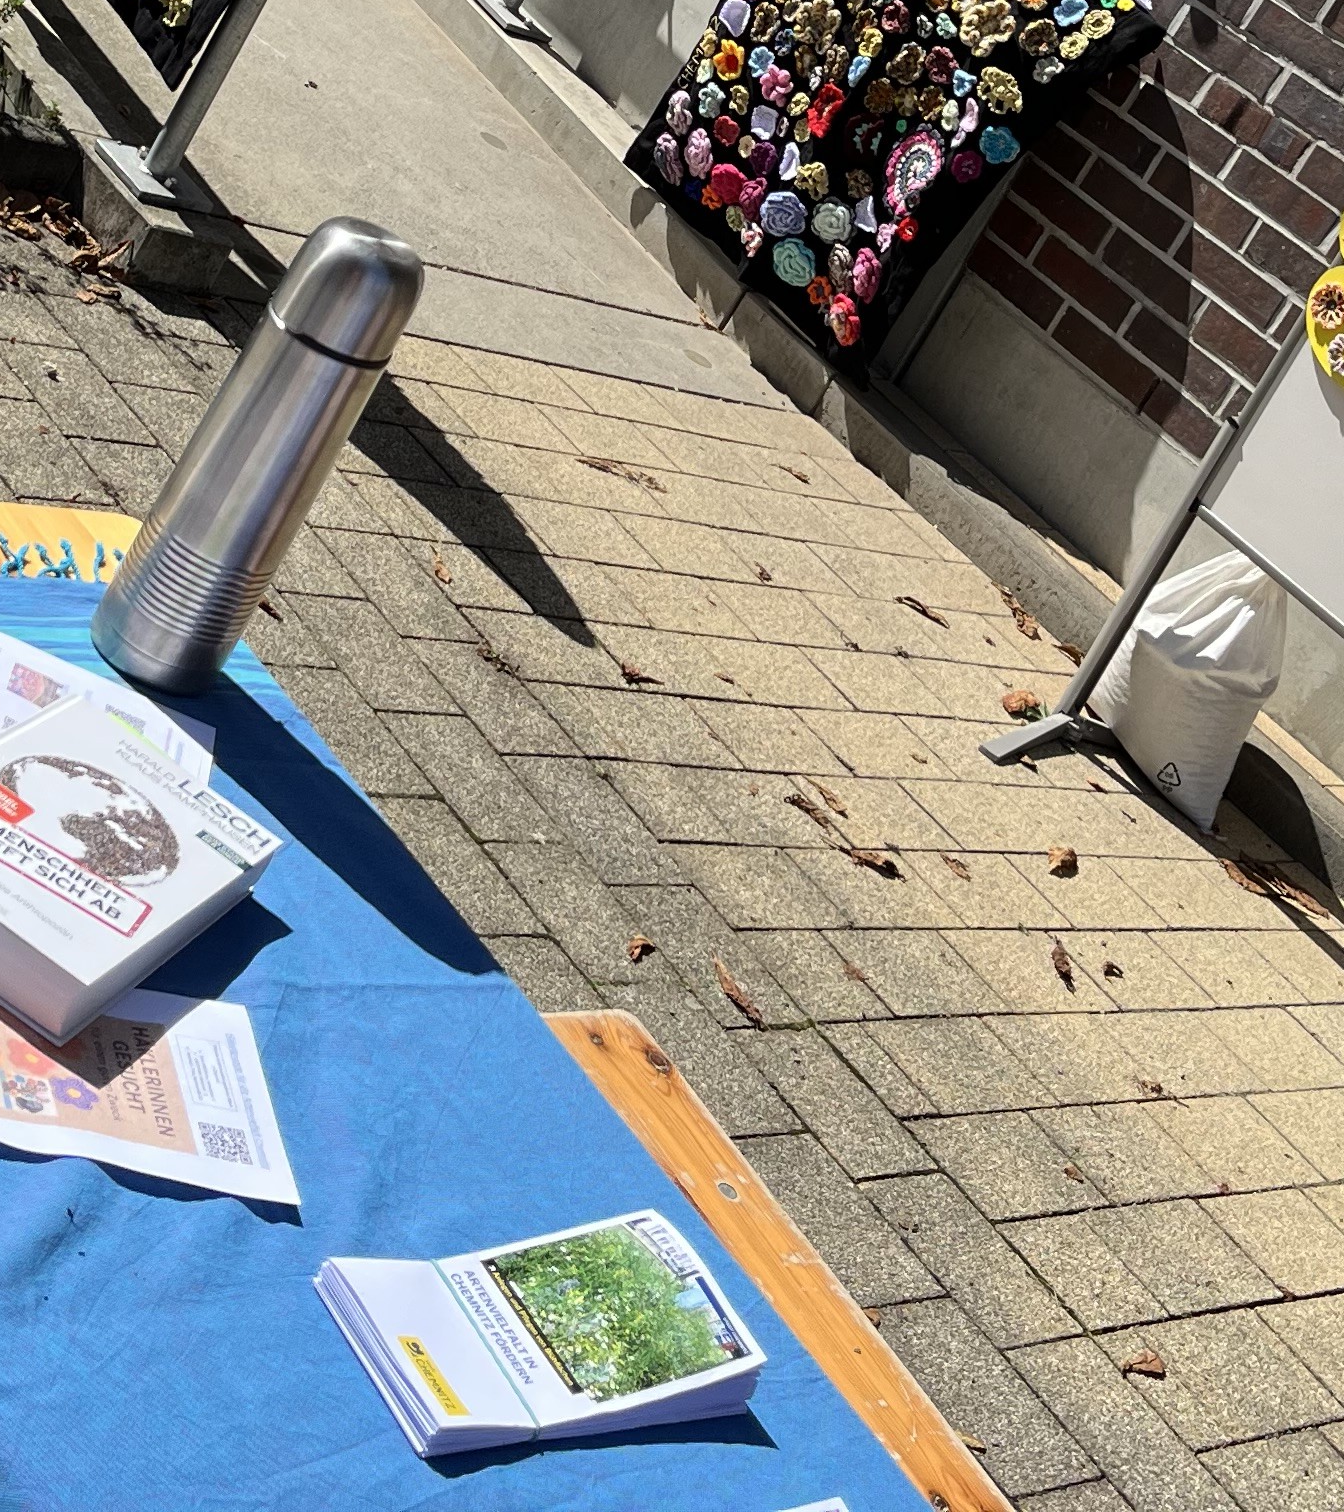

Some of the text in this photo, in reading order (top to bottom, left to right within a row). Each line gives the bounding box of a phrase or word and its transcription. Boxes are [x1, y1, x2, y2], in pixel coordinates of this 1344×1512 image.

[115, 748, 161, 784] KLAUS
[163, 782, 262, 856] KAMPHAUSEN
[119, 739, 271, 848] HARALD LESCH
[34, 863, 88, 899] SICH
[89, 897, 122, 920] AB
[111, 1041, 145, 1113] GESUCHT
[131, 1027, 175, 1137] HÄKLERINNEN
[451, 1273, 534, 1385] CHEMNITZ FÖRDERN
[464, 1270, 538, 1369] ARTENVIELFALT IN
